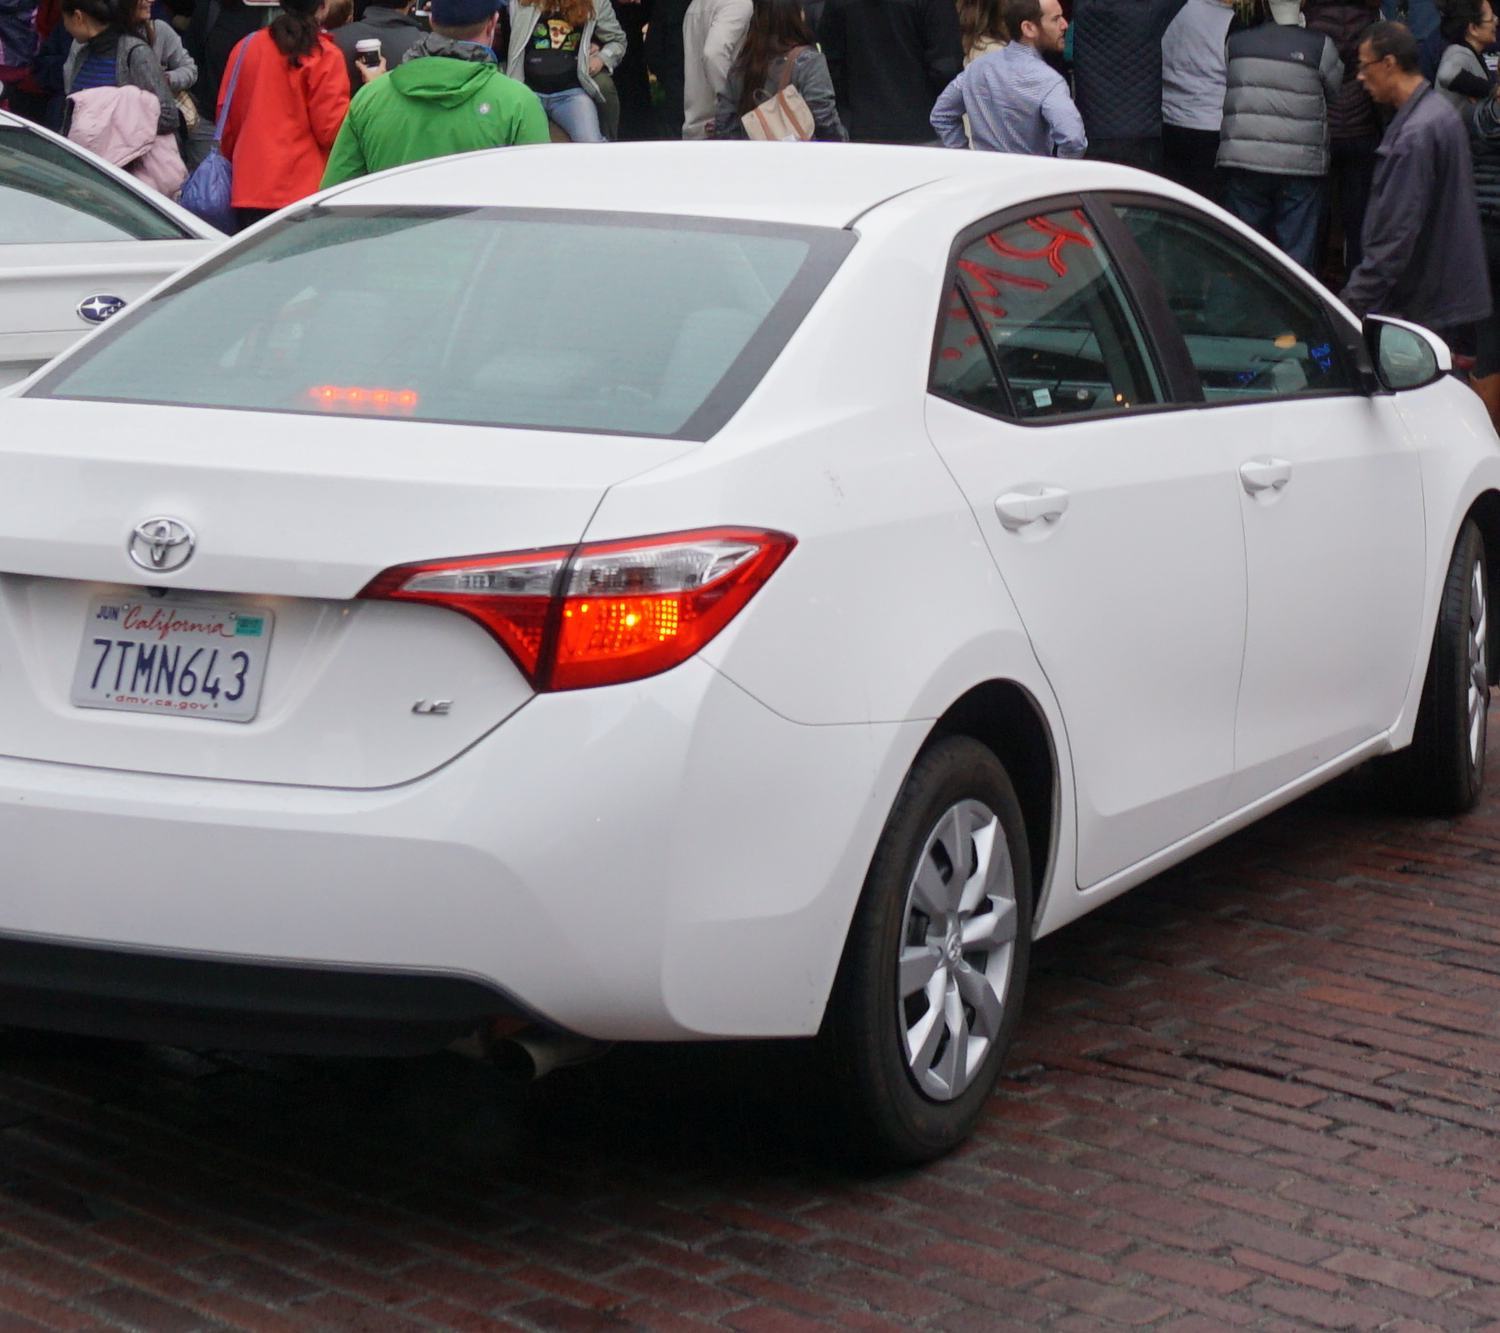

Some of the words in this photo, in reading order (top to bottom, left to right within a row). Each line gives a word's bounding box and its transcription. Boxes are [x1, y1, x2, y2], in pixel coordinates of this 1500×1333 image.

[96, 604, 121, 621] JUN
[124, 605, 235, 640] California
[90, 637, 250, 701] 7TMN643
[115, 693, 210, 710] dmv.ca.gov
[411, 697, 455, 716] LE
